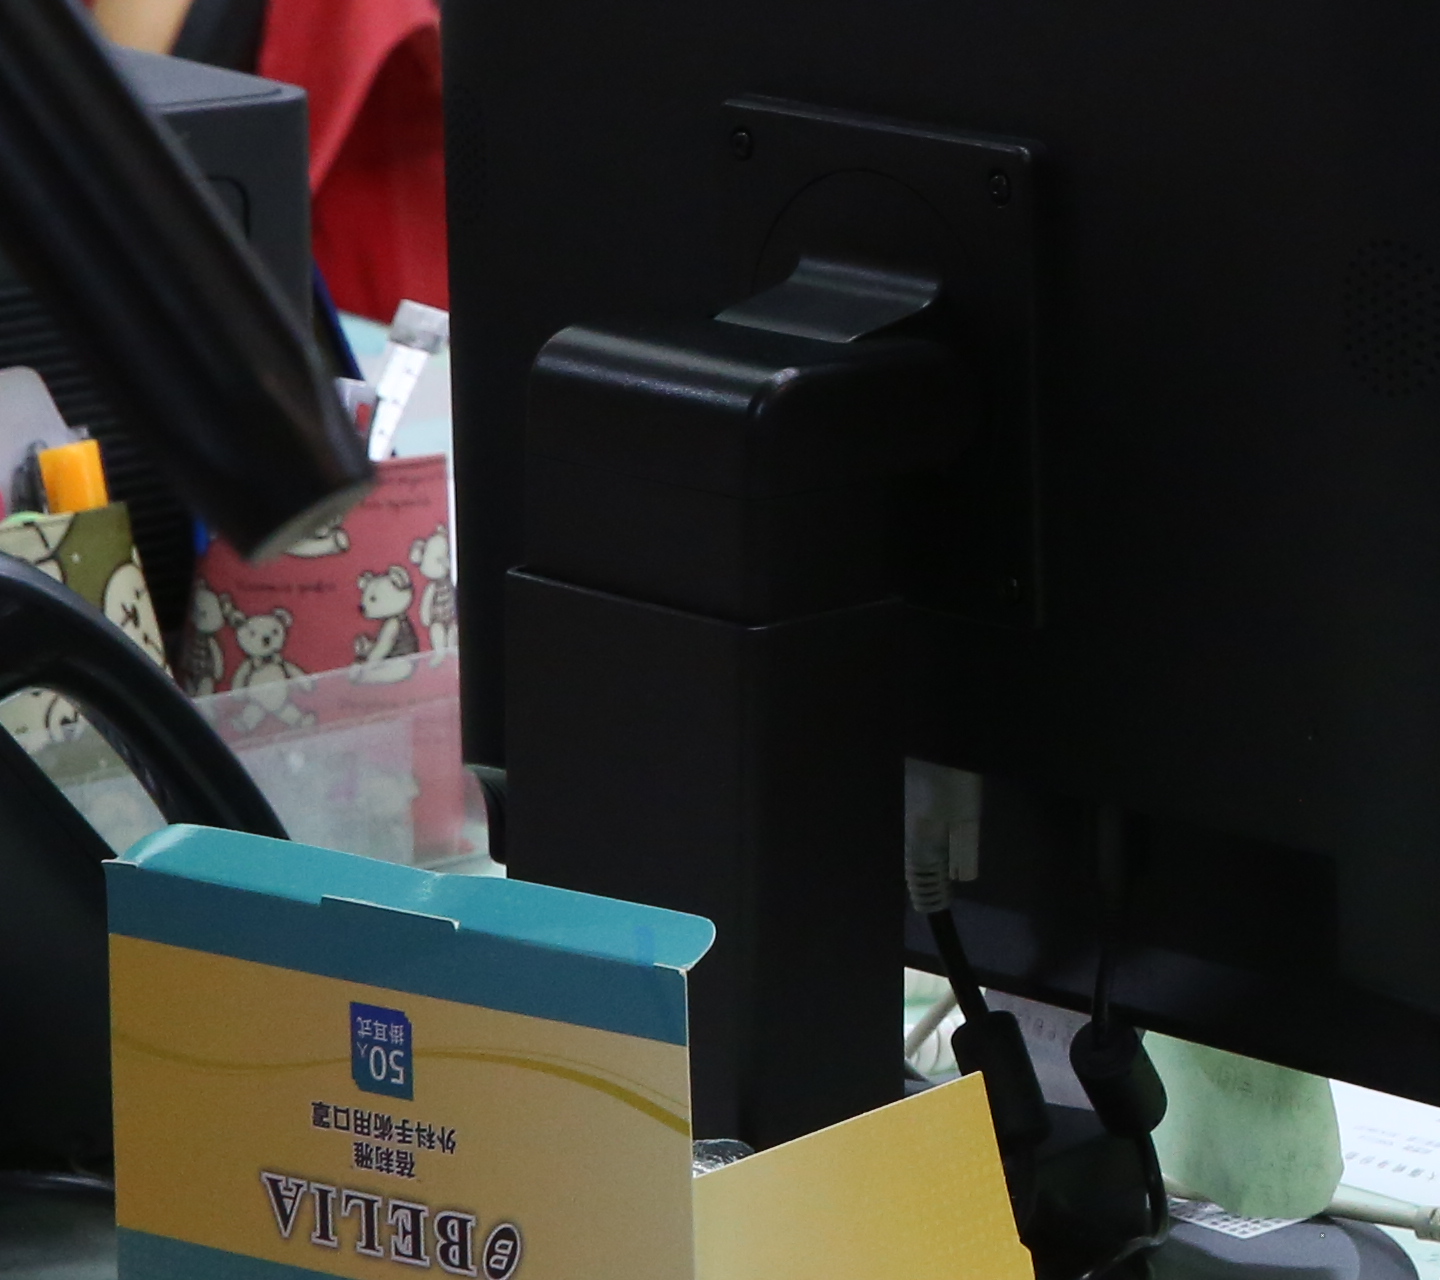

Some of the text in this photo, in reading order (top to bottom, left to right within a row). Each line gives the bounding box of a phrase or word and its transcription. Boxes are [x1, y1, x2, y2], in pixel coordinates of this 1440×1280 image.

[355, 1016, 405, 1045] 掛耳式
[310, 1101, 457, 1155] 外科手術用口罩
[351, 1141, 416, 1180] 蓓莉雅
